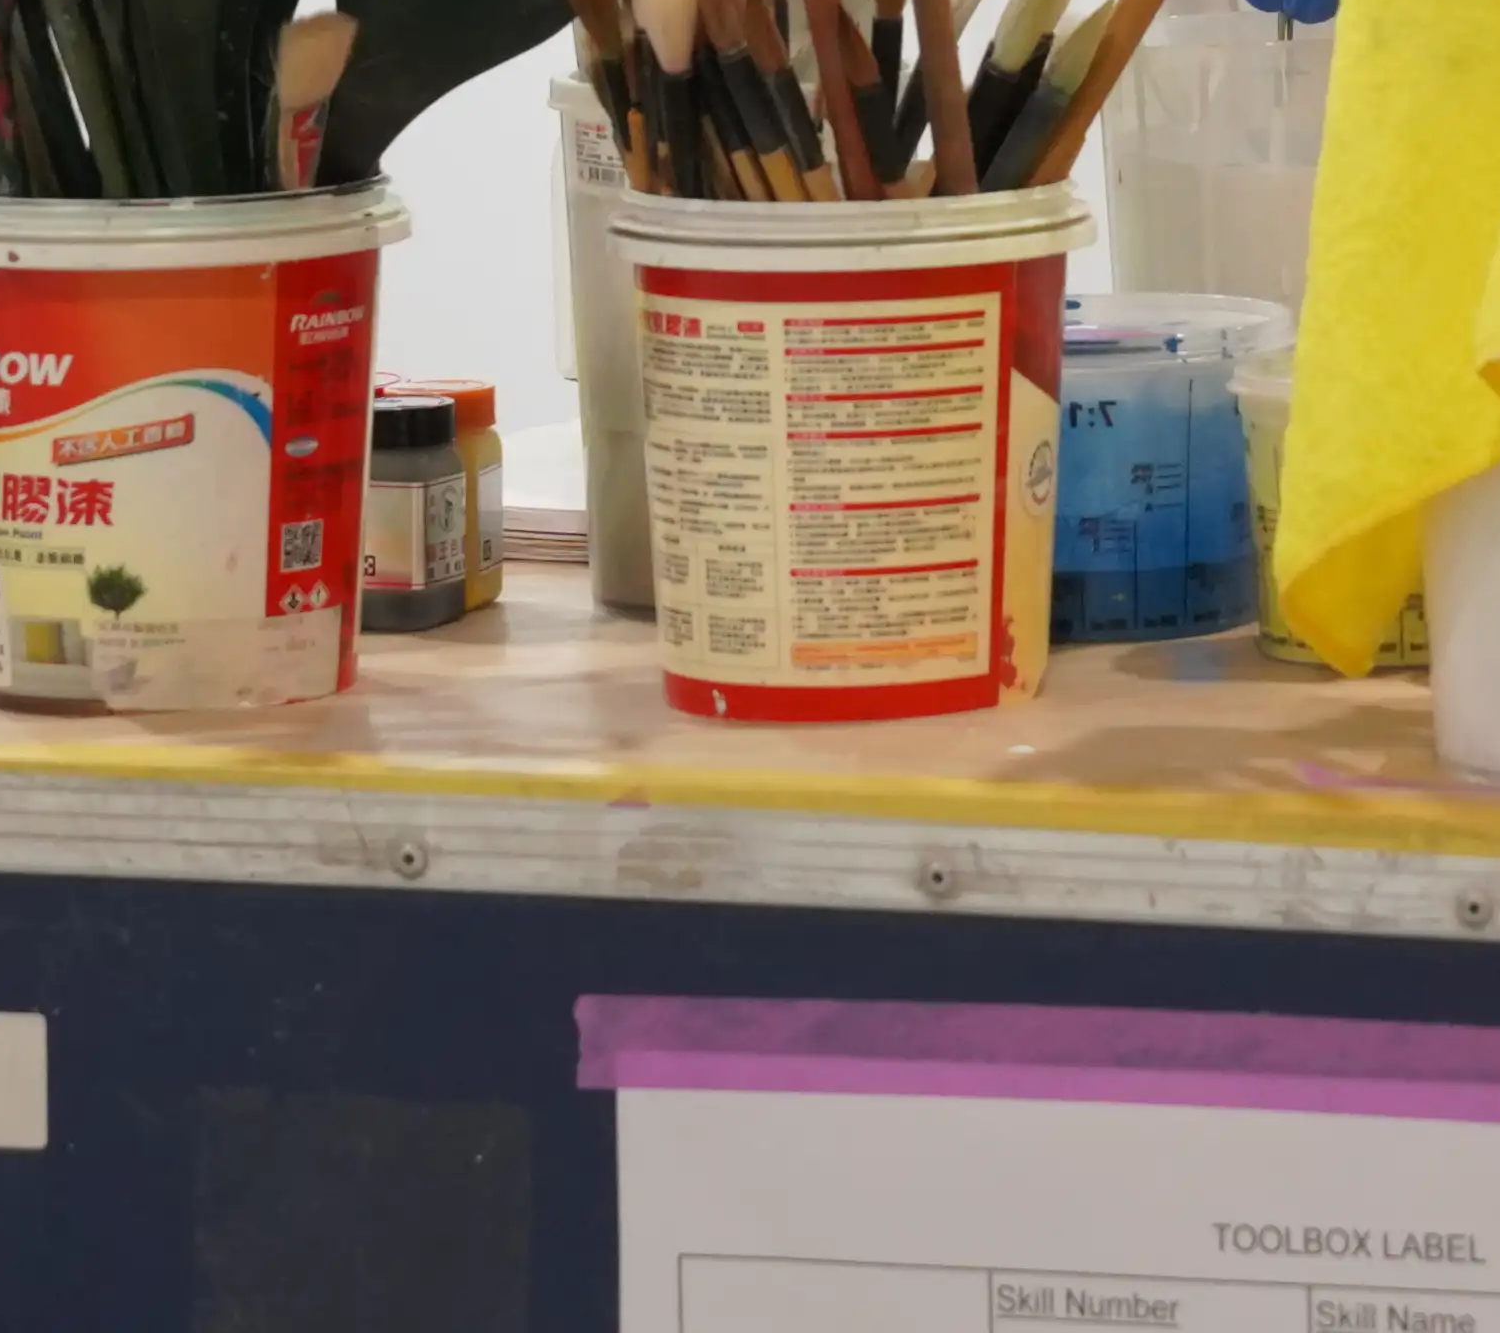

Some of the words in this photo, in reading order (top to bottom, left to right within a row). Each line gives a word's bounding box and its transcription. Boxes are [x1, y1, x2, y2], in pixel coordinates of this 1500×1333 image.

[1212, 1222, 1373, 1259] TOOLBOX
[1383, 1231, 1486, 1265] LABEL
[996, 1284, 1055, 1317] Skill
[1064, 1287, 1179, 1325] Number
[1314, 1300, 1378, 1331] Skill
[1386, 1304, 1476, 1333] Name
